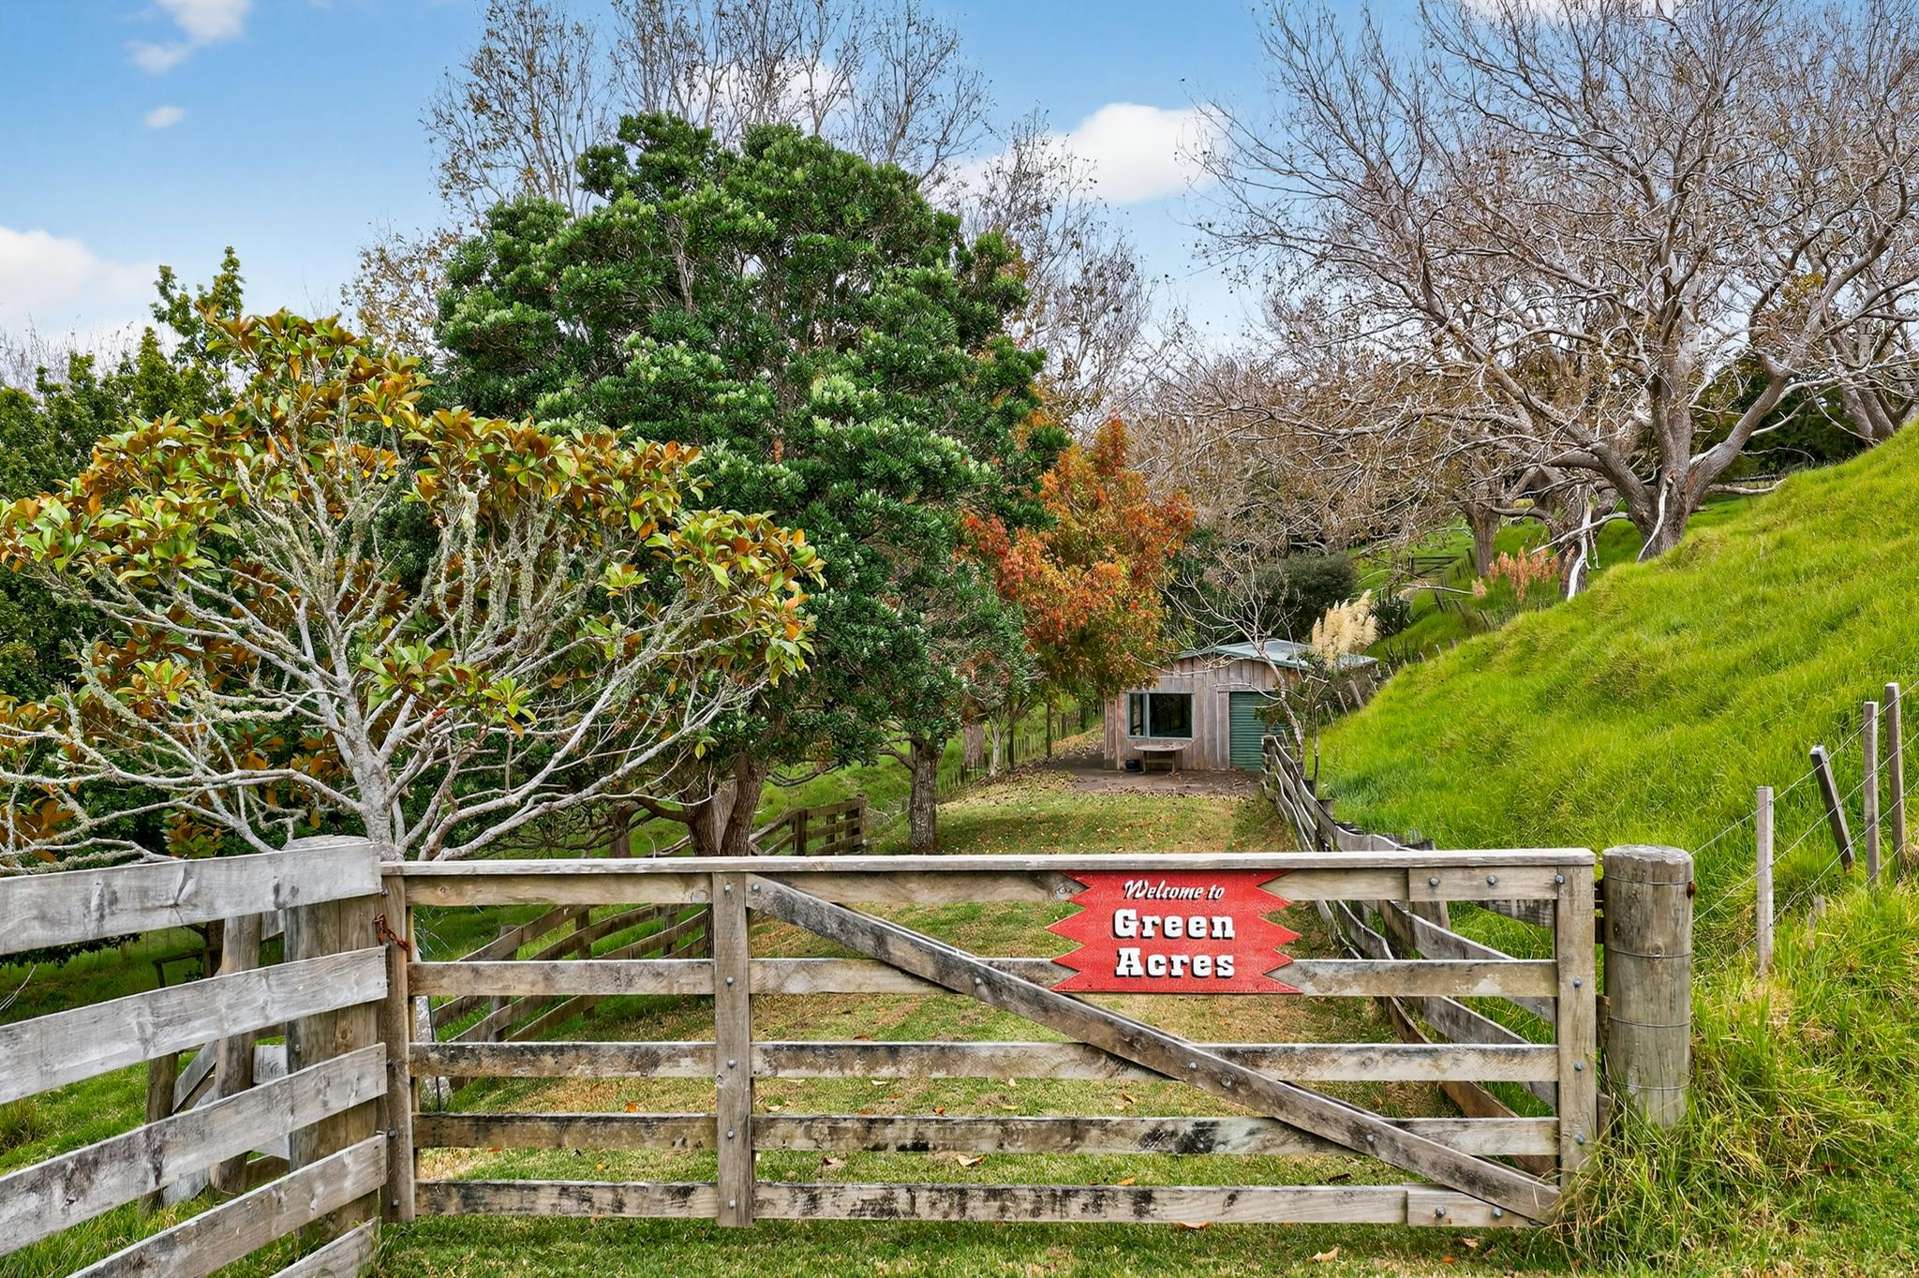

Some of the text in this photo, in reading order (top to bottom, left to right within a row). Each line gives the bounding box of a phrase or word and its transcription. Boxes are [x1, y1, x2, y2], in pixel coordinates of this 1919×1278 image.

[1123, 879, 1226, 900] Welcome to
[1113, 908, 1236, 938] Green
[1115, 947, 1236, 977] Acres
